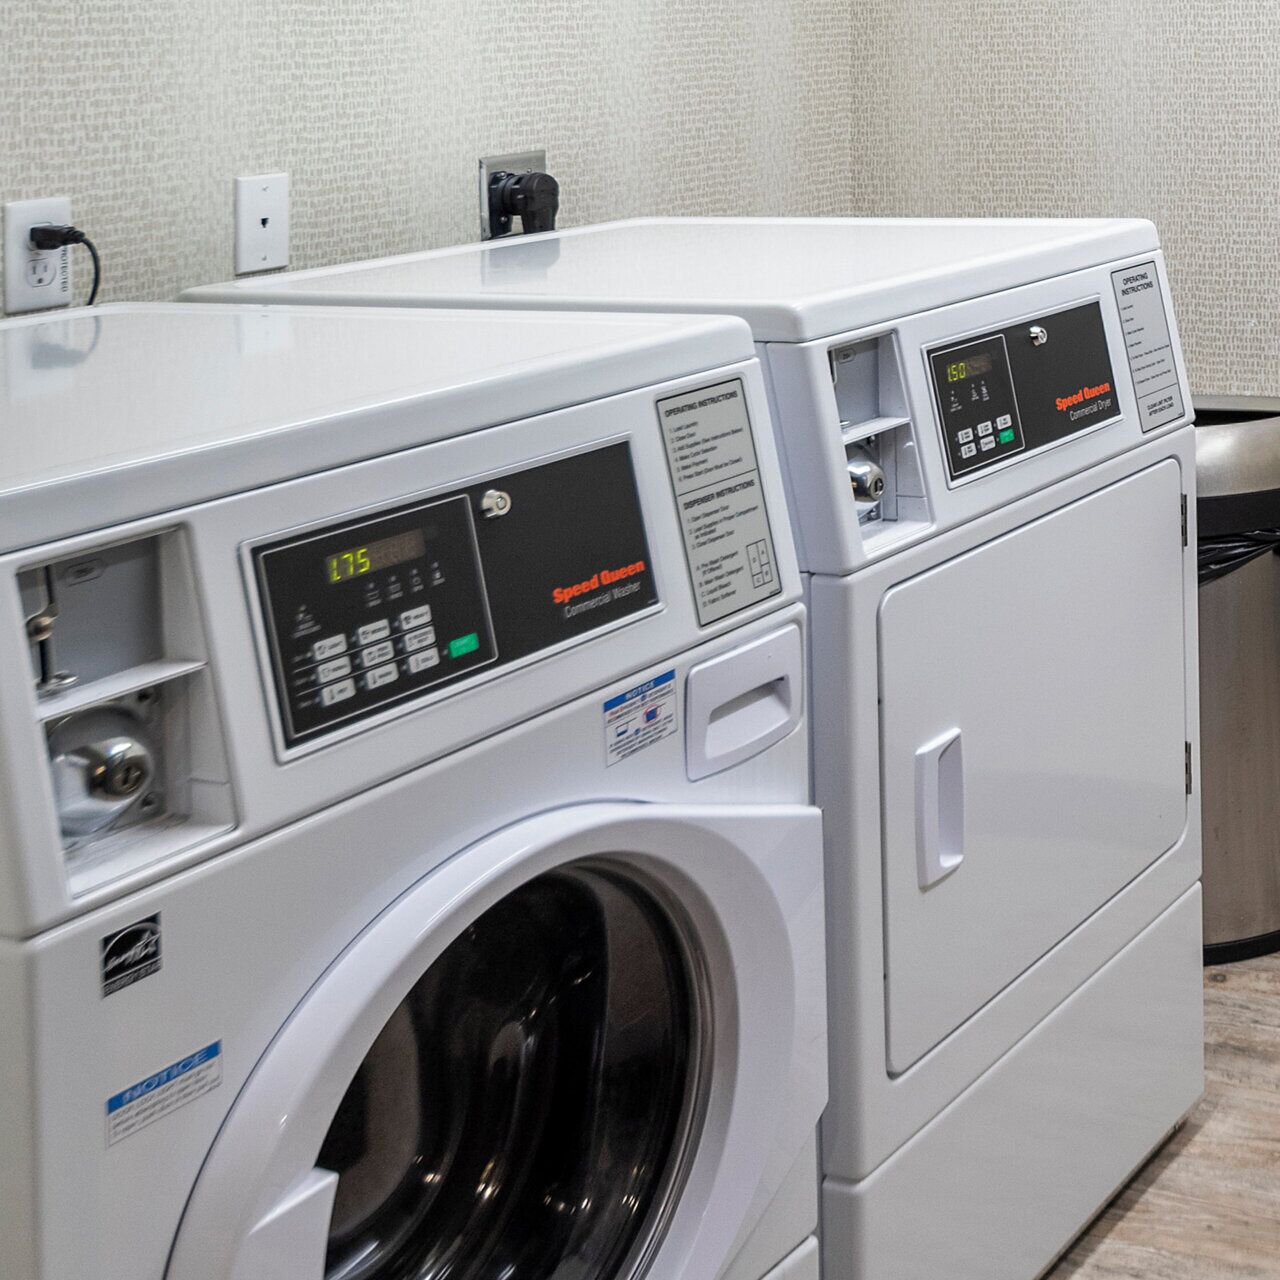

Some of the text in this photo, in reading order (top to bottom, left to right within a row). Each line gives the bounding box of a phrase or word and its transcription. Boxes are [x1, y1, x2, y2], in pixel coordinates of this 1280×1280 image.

[1121, 281, 1154, 296] INSTRUCTIONS
[1123, 272, 1148, 286] OPERATING
[664, 390, 738, 418] OPERATING INSTRUCTIONS
[1056, 383, 1111, 411] Speed Queen
[1069, 399, 1112, 421] Commercial Dryer
[683, 479, 756, 510] DISPENSER INSTRUCTIONS
[553, 560, 645, 604] Speed Queen
[565, 581, 641, 618] Commercial Washer
[122, 1050, 209, 1105] NOTICE
